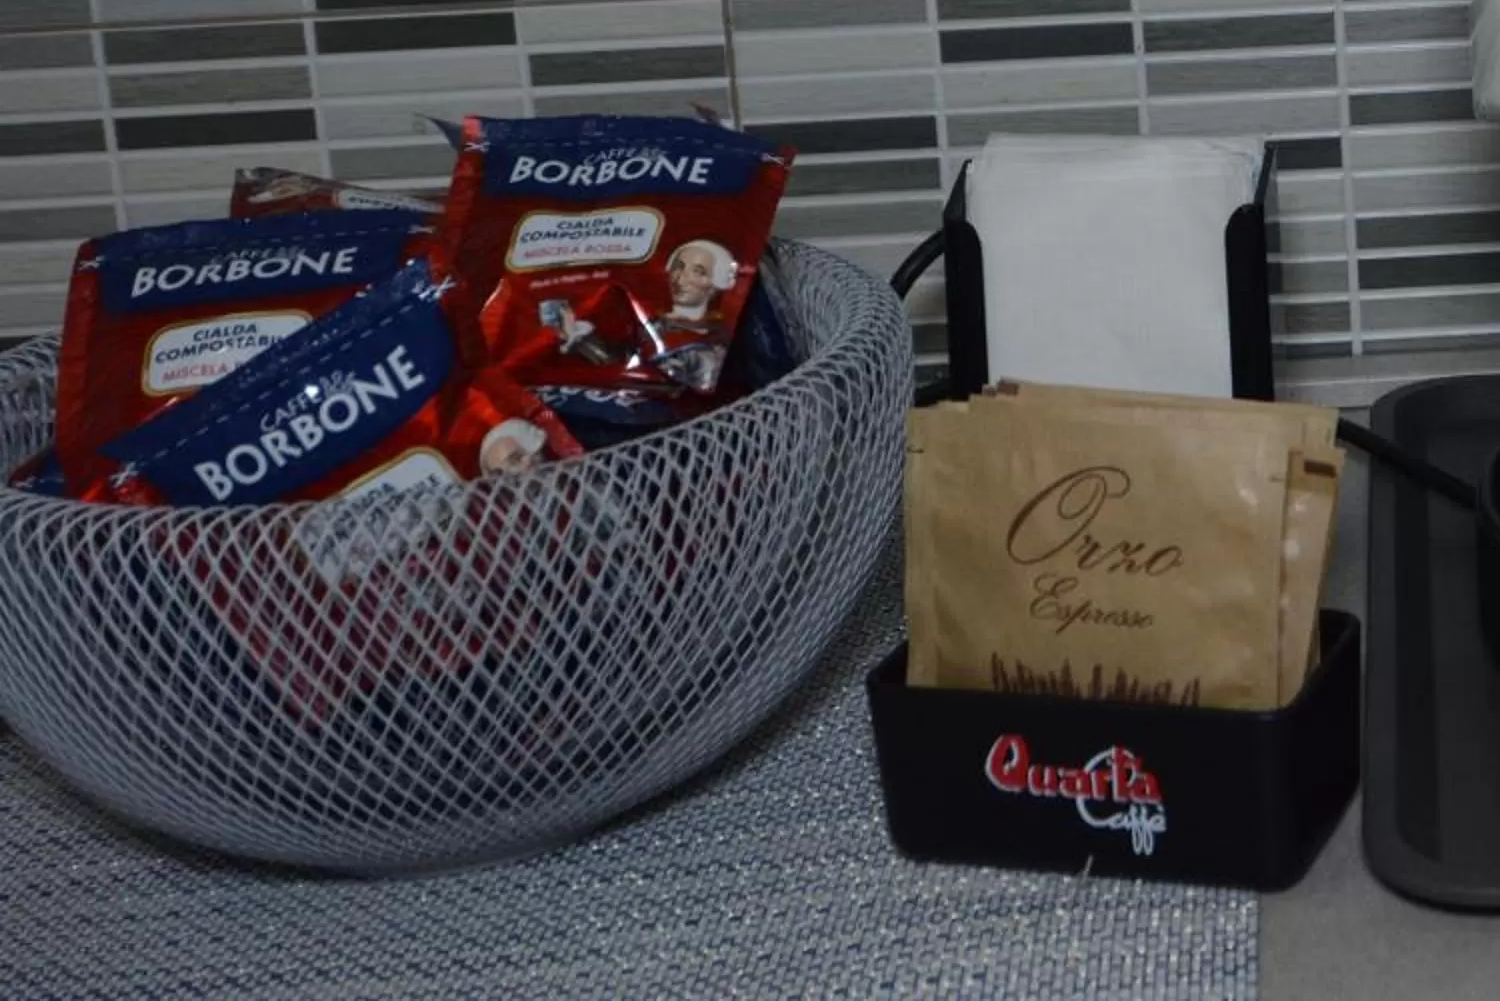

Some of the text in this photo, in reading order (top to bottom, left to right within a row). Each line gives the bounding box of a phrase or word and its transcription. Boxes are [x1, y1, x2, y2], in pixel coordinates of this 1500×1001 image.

[509, 155, 714, 186] BORBONE
[520, 226, 646, 243] COMPOSTABILE
[131, 247, 358, 298] BORBONE
[193, 324, 257, 342] CIALDA
[194, 344, 426, 501] BORBONE
[1007, 466, 1184, 576] Orzo
[1030, 574, 1153, 635] Espresso
[985, 733, 1163, 804] Quarta
